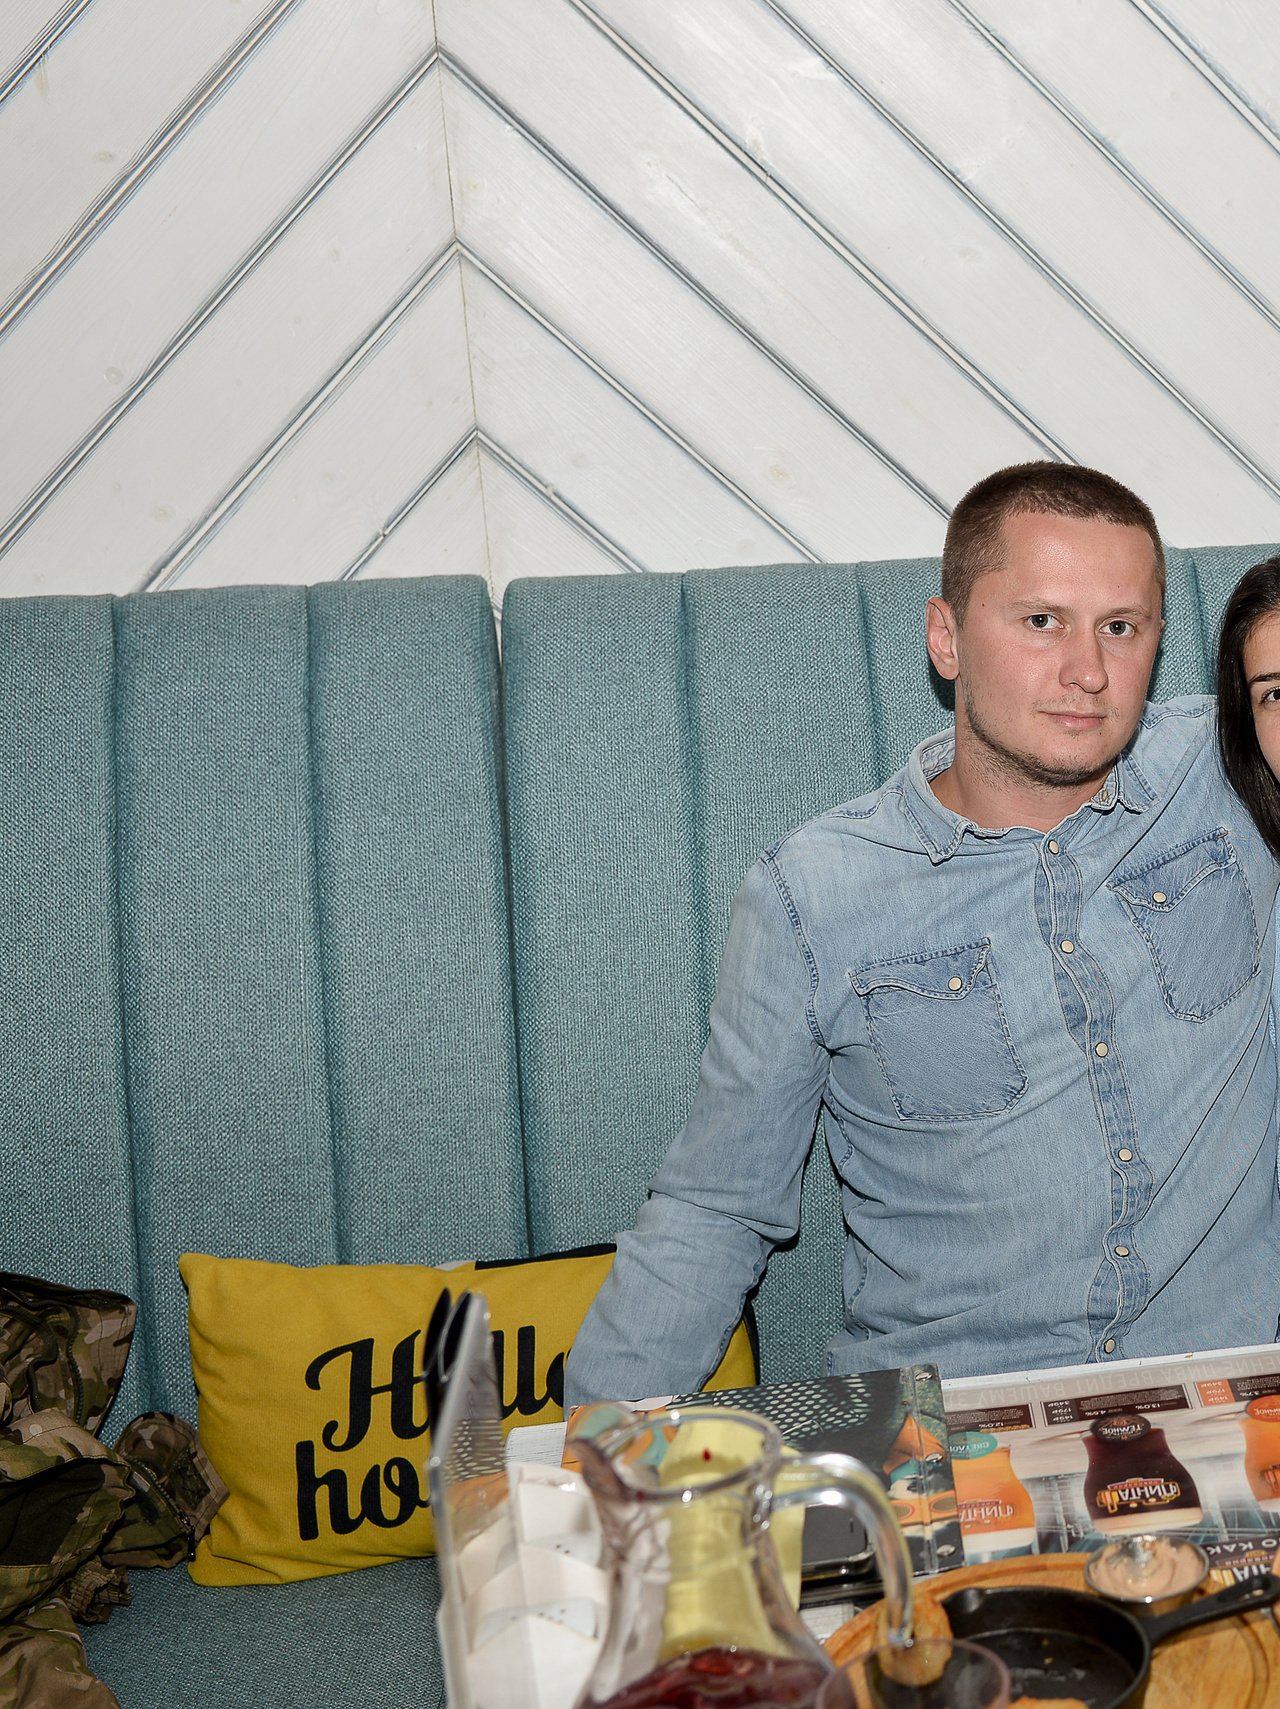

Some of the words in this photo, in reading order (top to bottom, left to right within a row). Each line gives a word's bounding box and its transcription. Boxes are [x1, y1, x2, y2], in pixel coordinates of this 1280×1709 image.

[1075, 1370, 1152, 1394] ВРЕДИТ
[1162, 1361, 1213, 1382] ПИВА
[305, 1325, 572, 1452] Hll
[977, 1381, 1064, 1406] ВАШЕМУ
[295, 1440, 432, 1541] ho
[1118, 1483, 1177, 1501] ПИНТА
[1206, 1541, 1253, 1555] КАК
